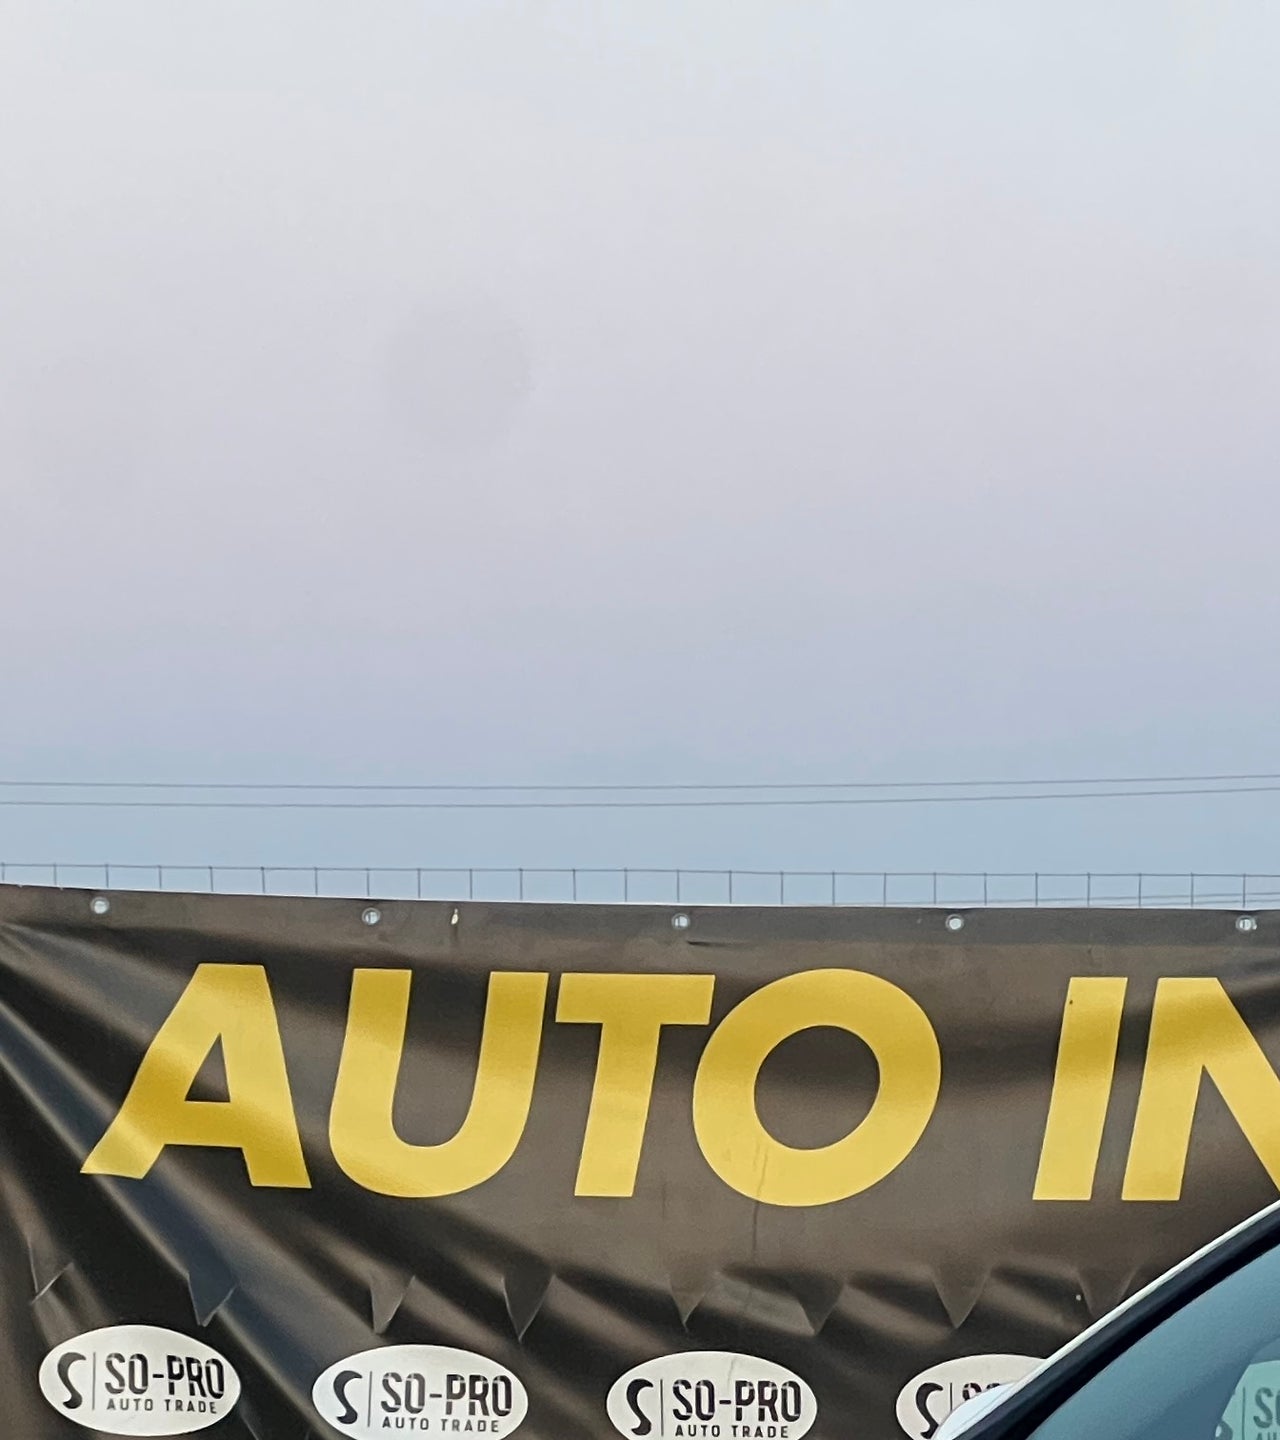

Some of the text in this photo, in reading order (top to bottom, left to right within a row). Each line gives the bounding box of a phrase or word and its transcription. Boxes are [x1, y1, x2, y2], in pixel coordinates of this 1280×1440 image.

[81, 963, 942, 1206] AUTO
[103, 1352, 227, 1399] SO-PRO
[380, 1372, 512, 1417] SO-PRO
[107, 1398, 217, 1414] AUTO TRADE
[672, 1379, 801, 1422] SO-PRO
[383, 1416, 498, 1432] AUTO TRADE
[675, 1425, 788, 1438] AUTO TRADE
